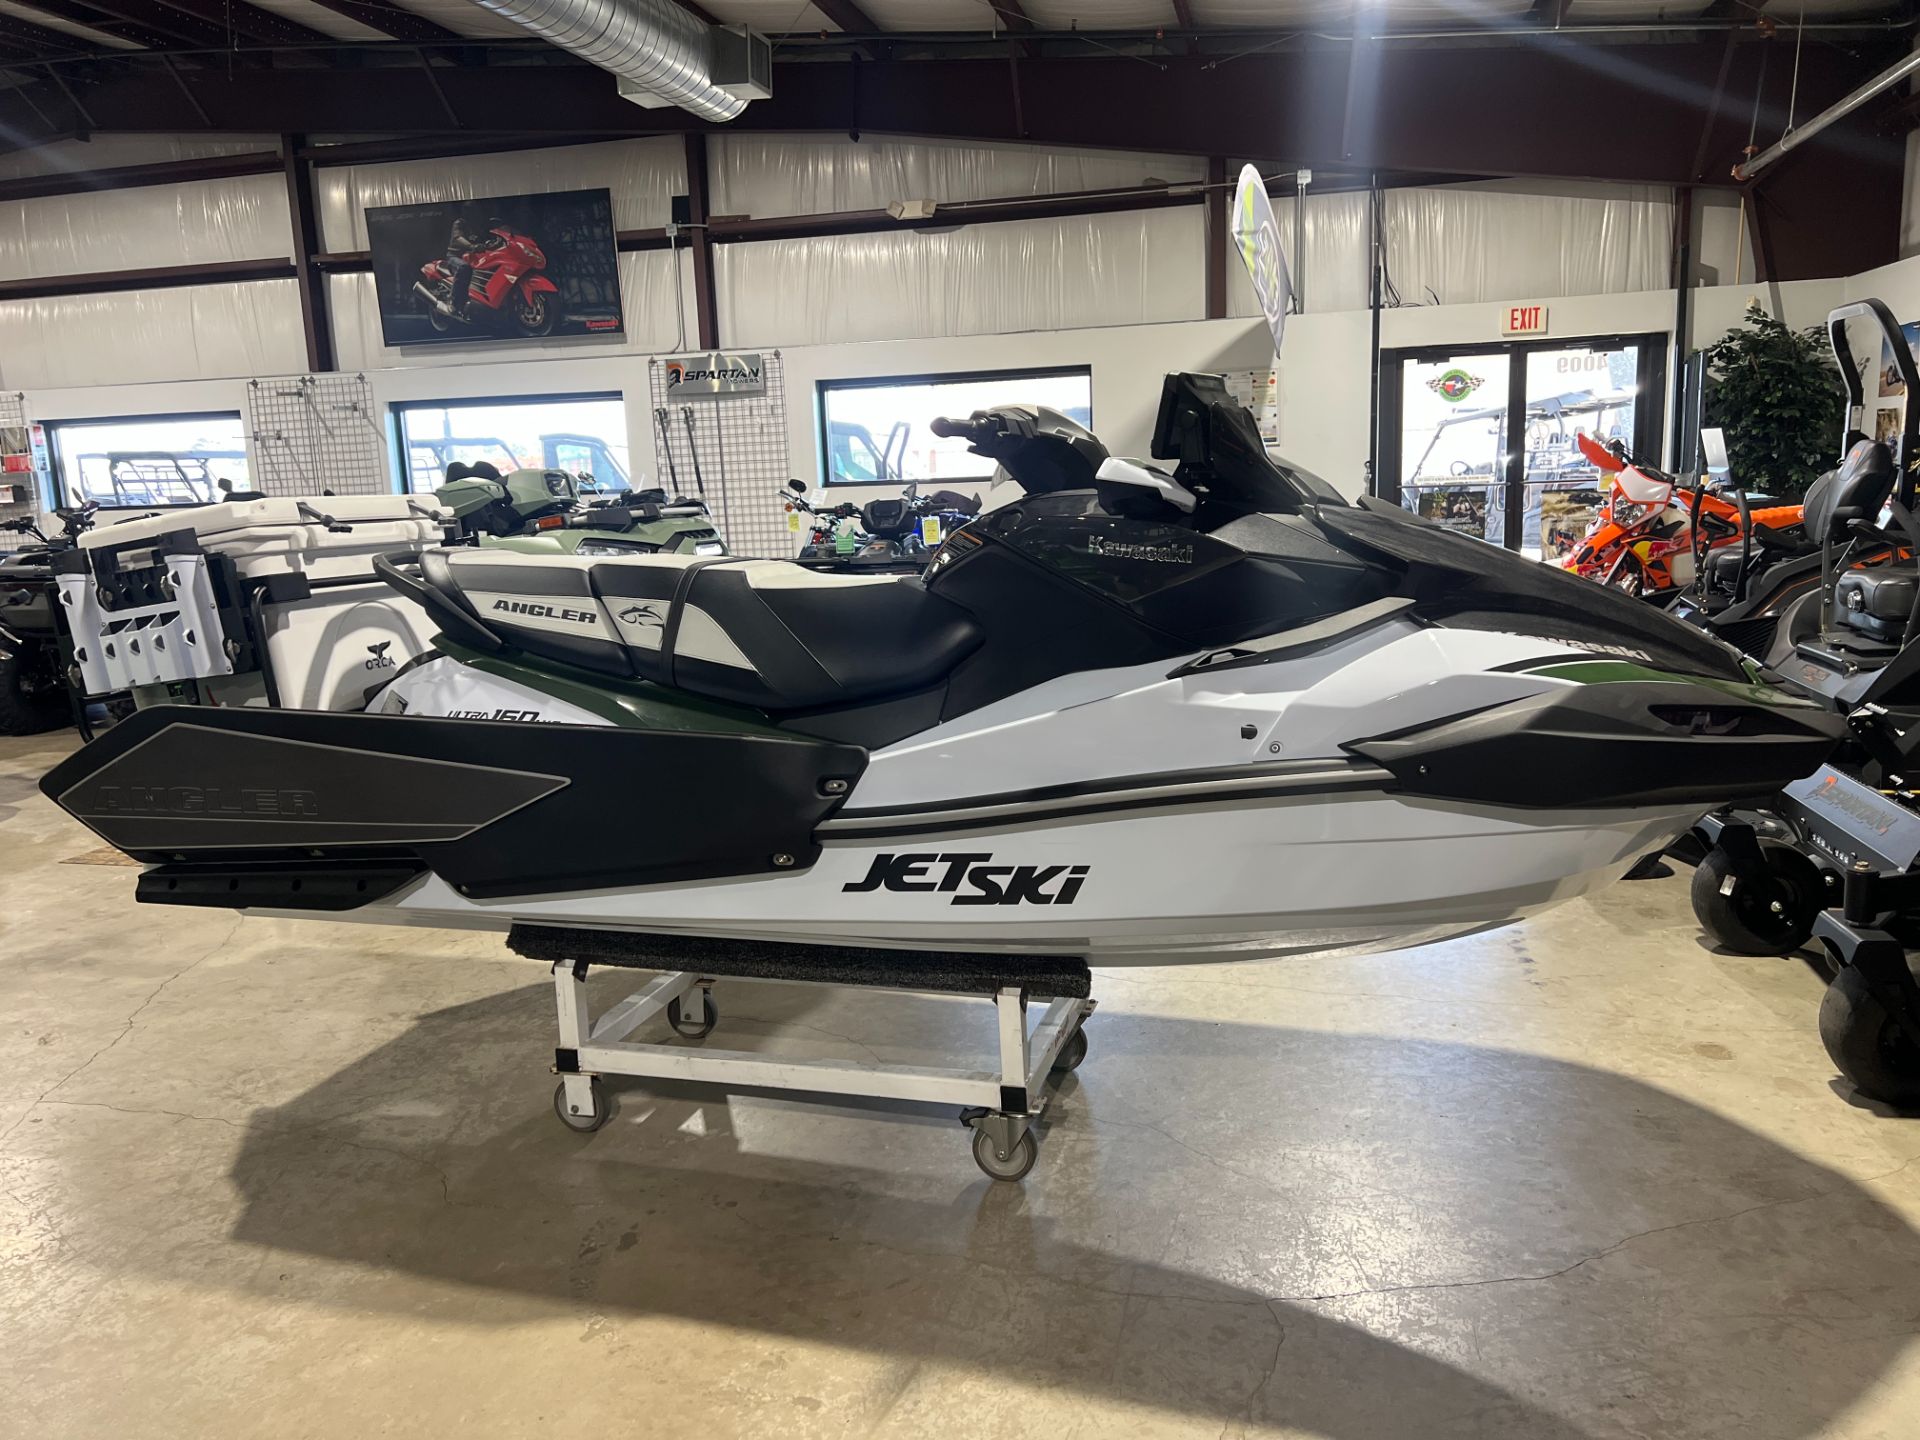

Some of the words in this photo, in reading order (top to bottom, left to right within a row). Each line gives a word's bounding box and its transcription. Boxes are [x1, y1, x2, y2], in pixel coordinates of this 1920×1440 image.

[1510, 307, 1541, 331] EXIT
[684, 368, 760, 381] SPARTAN
[1088, 535, 1193, 564] Kawasaki
[493, 599, 597, 624] ANGLER
[365, 656, 396, 670] ORCA
[447, 710, 489, 719] ULTRA
[94, 786, 318, 815] ANGLER
[842, 853, 993, 892] JET
